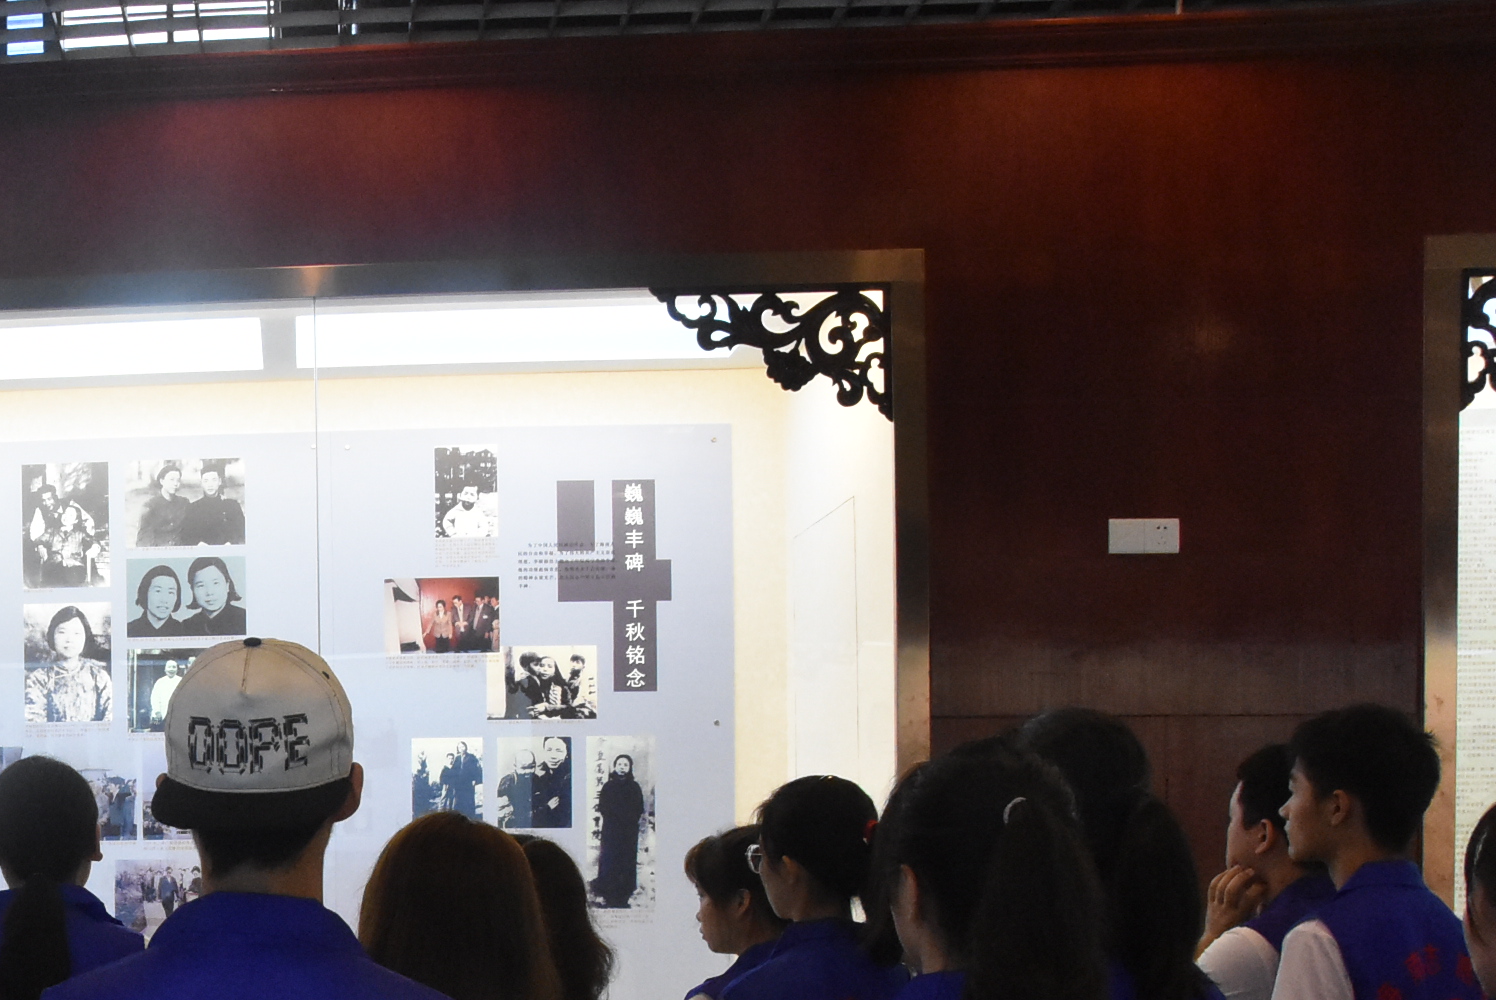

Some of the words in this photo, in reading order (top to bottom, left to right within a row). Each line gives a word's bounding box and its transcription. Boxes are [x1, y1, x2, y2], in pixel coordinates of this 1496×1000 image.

[624, 482, 645, 572] 巍巍丰碑
[625, 599, 646, 689] 千秋铭念
[188, 712, 310, 775] DOPE
